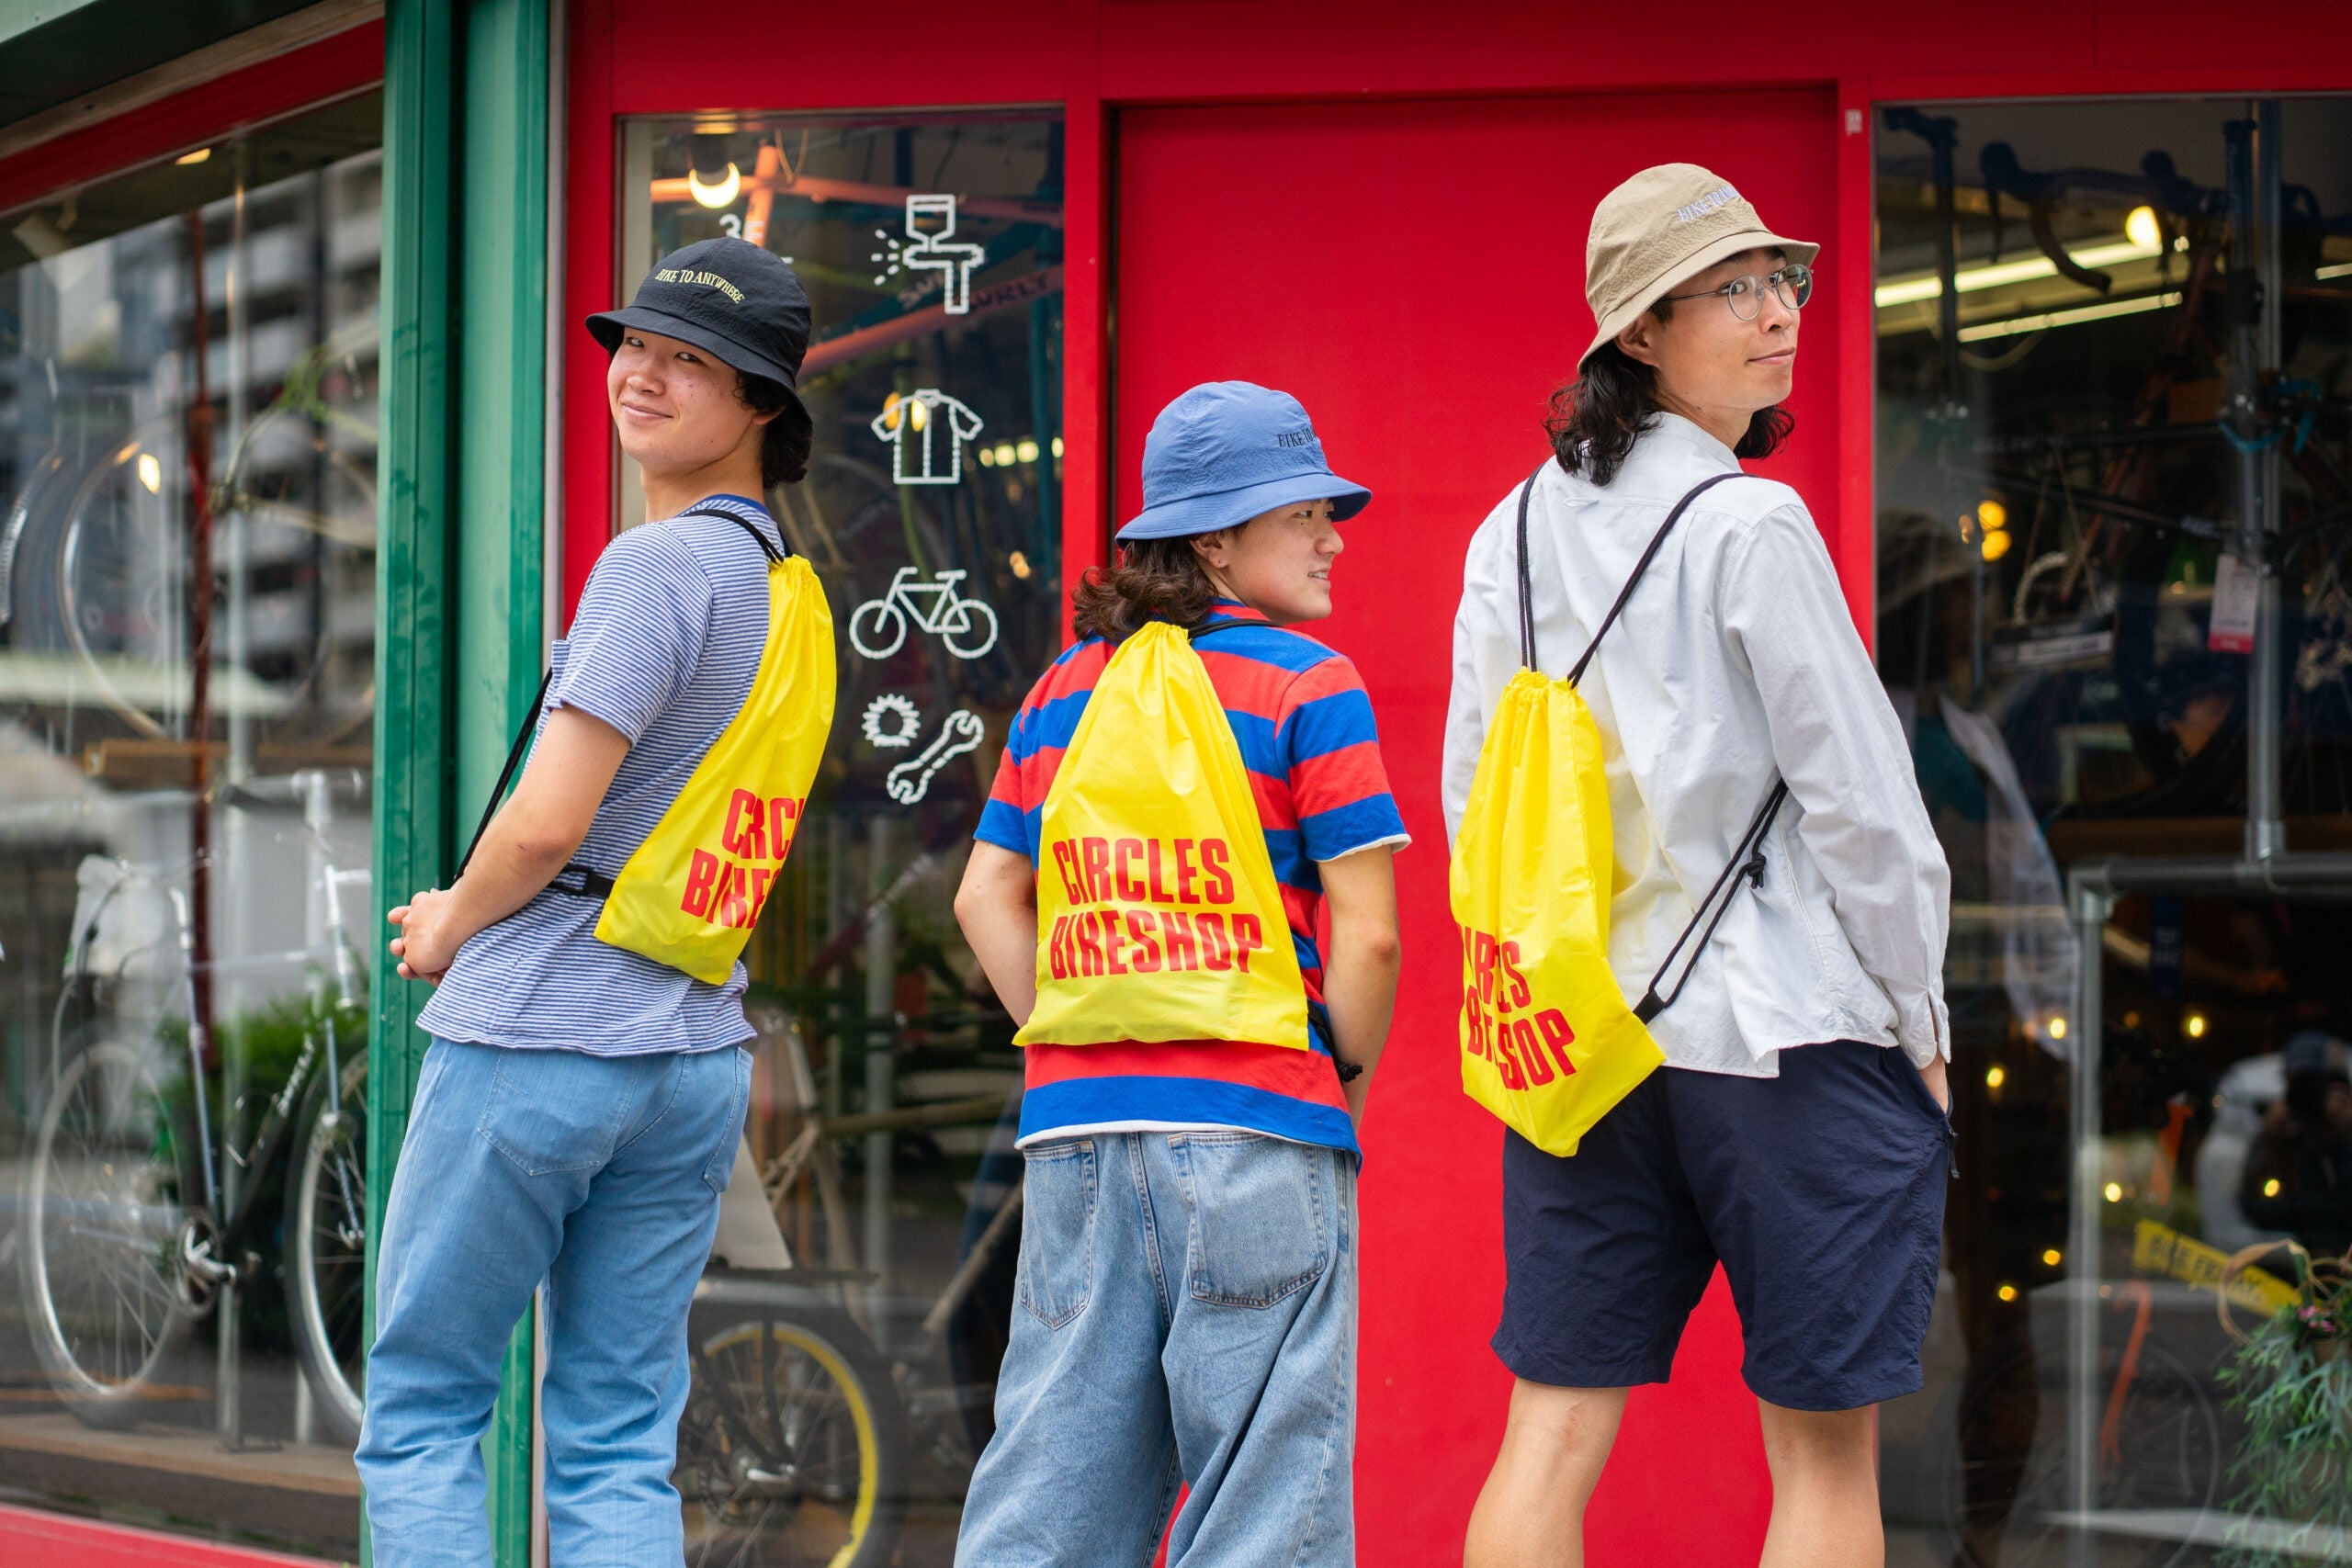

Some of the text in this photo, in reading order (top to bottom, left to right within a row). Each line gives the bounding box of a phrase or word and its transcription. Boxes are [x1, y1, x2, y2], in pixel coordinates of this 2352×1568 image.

[1677, 199, 1710, 222] BIKE
[1705, 191, 1724, 207] TO
[655, 269, 744, 304] BIKE TO ANYWHERE
[1277, 432, 1304, 447] BIKE
[1302, 427, 1314, 443] TO
[680, 848, 781, 929] BIKE
[1052, 837, 1235, 906] CIRCLES
[1050, 909, 1262, 980] BIKESHOP
